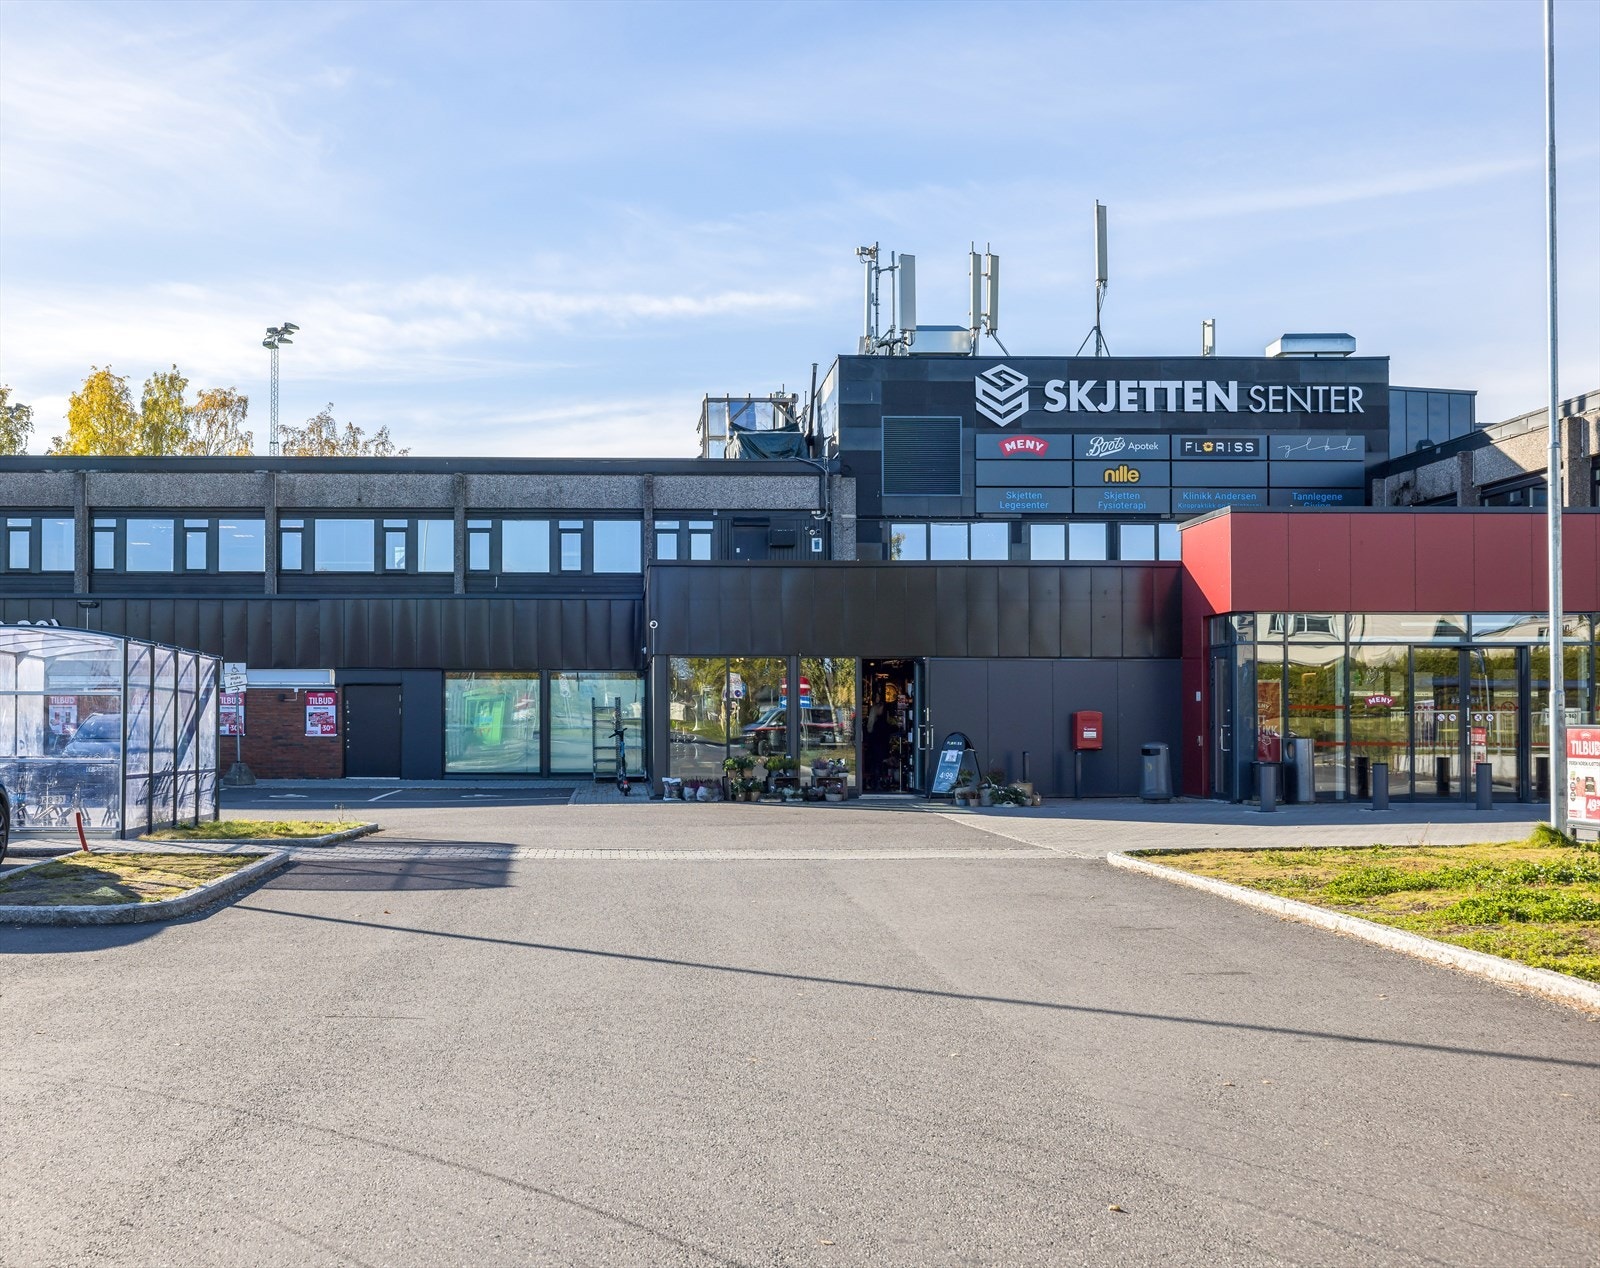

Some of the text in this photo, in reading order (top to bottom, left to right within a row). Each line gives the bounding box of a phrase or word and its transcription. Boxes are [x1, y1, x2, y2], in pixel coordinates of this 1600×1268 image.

[1043, 379, 1365, 414] SKJETTEN SENTER
[1004, 439, 1044, 452] MENY
[1085, 436, 1159, 457] Boots Apotek
[1104, 465, 1140, 483] nille
[1005, 491, 1043, 501] Skjetten
[1103, 491, 1141, 501] Skjetten
[1182, 491, 1257, 500] Klinikk Andersen
[1292, 492, 1343, 502] Tannlegene
[999, 501, 1049, 511] Legesenter
[1097, 501, 1147, 511] Fysioterapi
[309, 696, 334, 705] TILBUD
[1368, 695, 1392, 705] MENY
